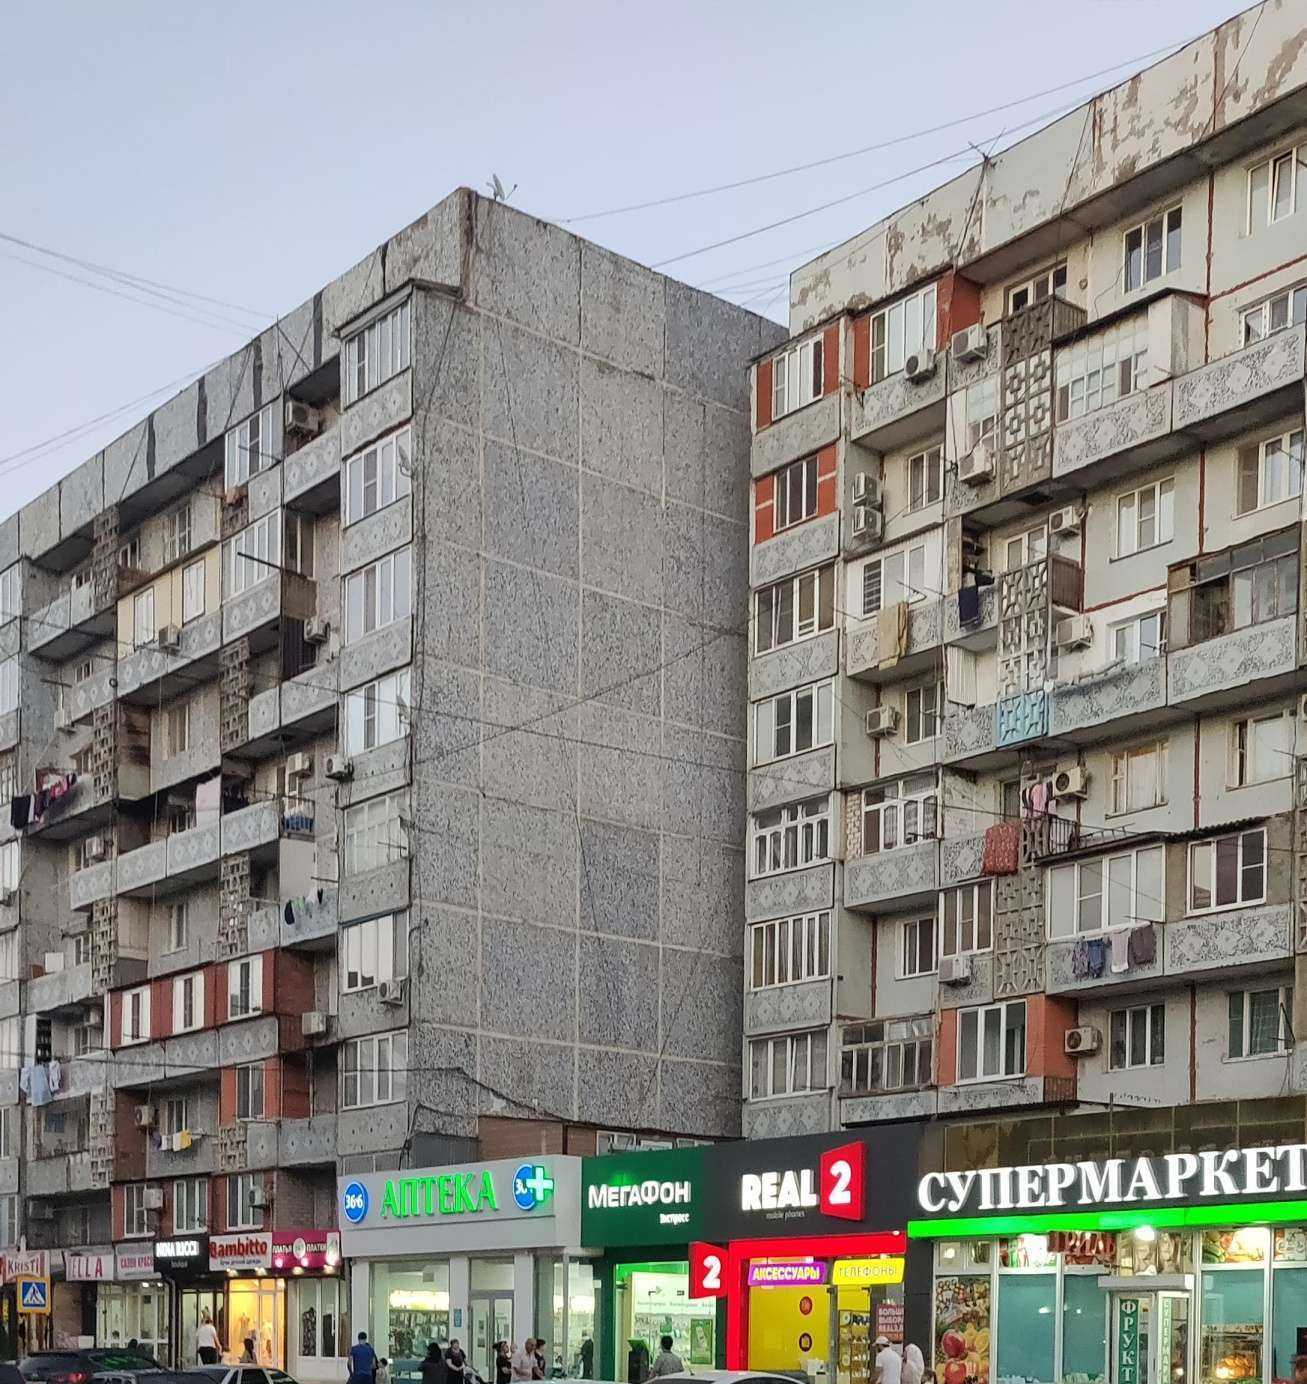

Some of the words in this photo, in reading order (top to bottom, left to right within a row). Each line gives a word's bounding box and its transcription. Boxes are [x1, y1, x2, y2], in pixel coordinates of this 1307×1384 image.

[741, 1168, 817, 1211] REAL
[828, 1159, 852, 1205] 2
[917, 1142, 1307, 1213] СУПЕРМАРКЕТ
[380, 1169, 498, 1218] АПТЕКА
[209, 1237, 268, 1258] Bambitto
[7, 1257, 40, 1275] KRISTI
[702, 1255, 721, 1289] 2
[752, 1266, 820, 1281] АКСЕССУАРЫ
[838, 1264, 897, 1278] ТЕЛЕФОНЫ
